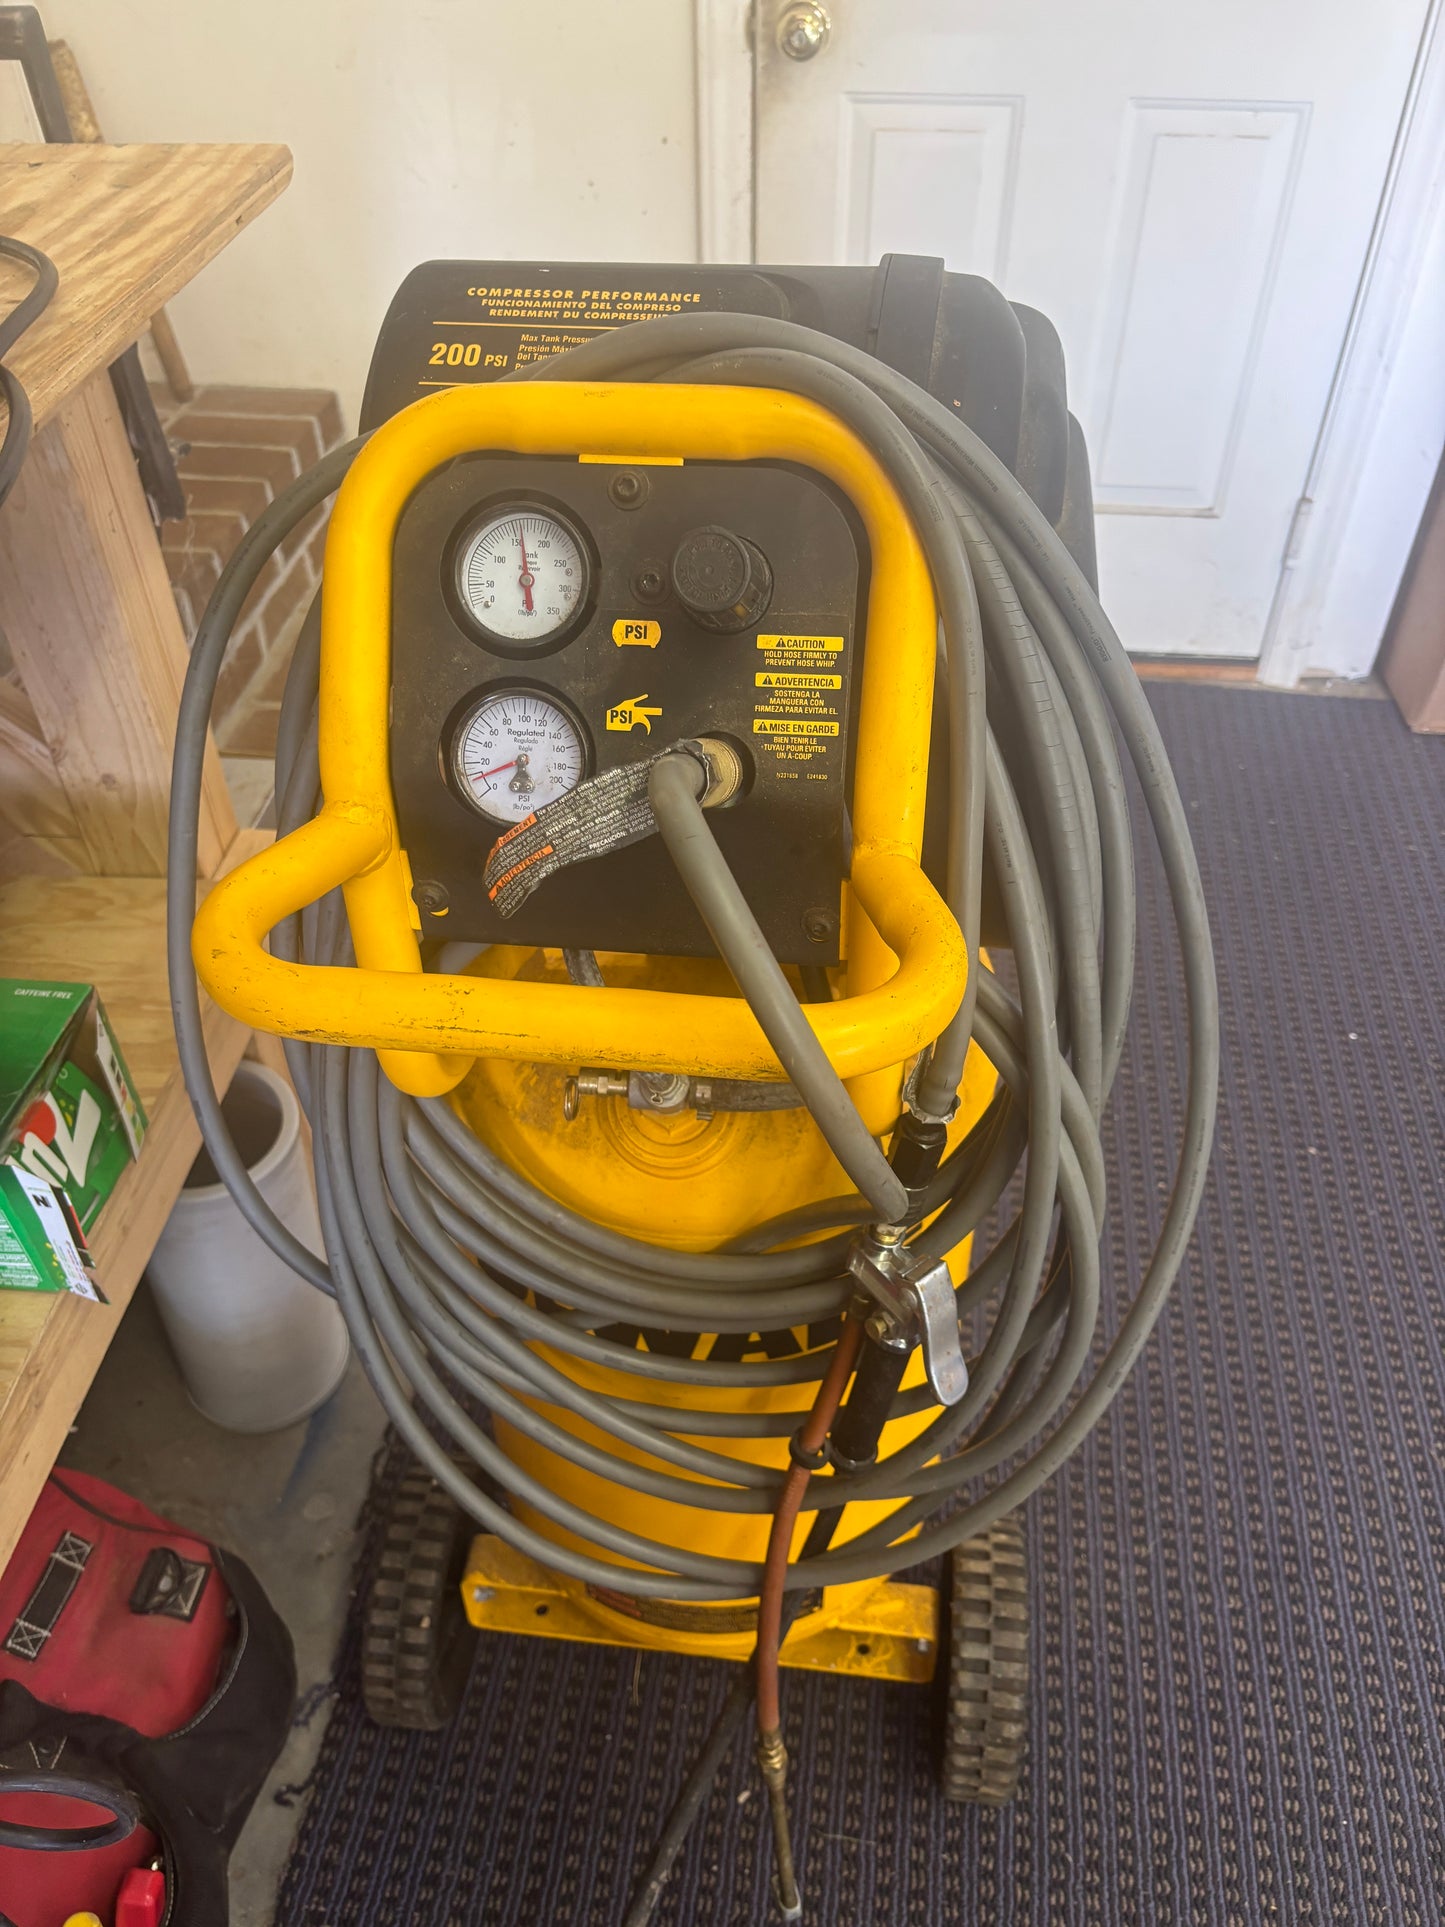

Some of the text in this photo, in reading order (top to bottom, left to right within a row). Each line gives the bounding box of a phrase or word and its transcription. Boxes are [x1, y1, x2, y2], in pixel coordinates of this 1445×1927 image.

[467, 287, 701, 303] COMPRESSOR PERFORMANCE
[481, 299, 681, 312] FUNCIONAMIENTO DEL COMPRESO
[489, 308, 559, 319] RENDEMENT
[563, 311, 580, 319] DU
[521, 333, 538, 343] Max
[540, 335, 561, 343] Tank
[519, 344, 550, 353] Presión
[428, 342, 481, 367] 200
[484, 354, 508, 367] PSI
[517, 353, 531, 361] Del
[538, 540, 551, 549] 200
[494, 555, 506, 564] 100
[526, 551, 539, 559] ank
[554, 560, 567, 568] 250
[485, 580, 495, 589] 50
[558, 584, 572, 593] 300
[490, 595, 495, 603] 0
[547, 607, 560, 615] 350
[624, 624, 648, 640] PSI
[786, 639, 825, 649] CAUTION
[764, 650, 782, 658] HOLD
[783, 651, 801, 659] HOSE
[829, 652, 838, 660] TO
[765, 659, 795, 667] PREVENT
[775, 677, 834, 688] ADVERTENCIA
[774, 690, 820, 699] SOSTENGA LA
[769, 698, 809, 706] MANGUERA
[754, 705, 784, 713] FIRMEZA
[785, 706, 803, 714] PARA
[518, 714, 531, 723] 100
[610, 710, 632, 724] PSI
[502, 718, 512, 726] 80
[534, 719, 548, 727] 120
[489, 728, 499, 736] 60
[507, 728, 545, 738] Regulated
[769, 723, 835, 734] MISE EN GARDE
[548, 732, 562, 740] 140
[773, 736, 817, 745] BIEN TENIR LE
[483, 741, 493, 749] 40
[513, 737, 539, 745] Regulado
[552, 745, 566, 753] 160
[786, 744, 804, 752] POUR
[480, 757, 490, 766] 20
[553, 762, 567, 770] 180
[549, 776, 563, 784] 200
[577, 781, 593, 793] cette
[518, 795, 530, 803] PSI
[14, 987, 74, 1000] CAFFEINE FREE
